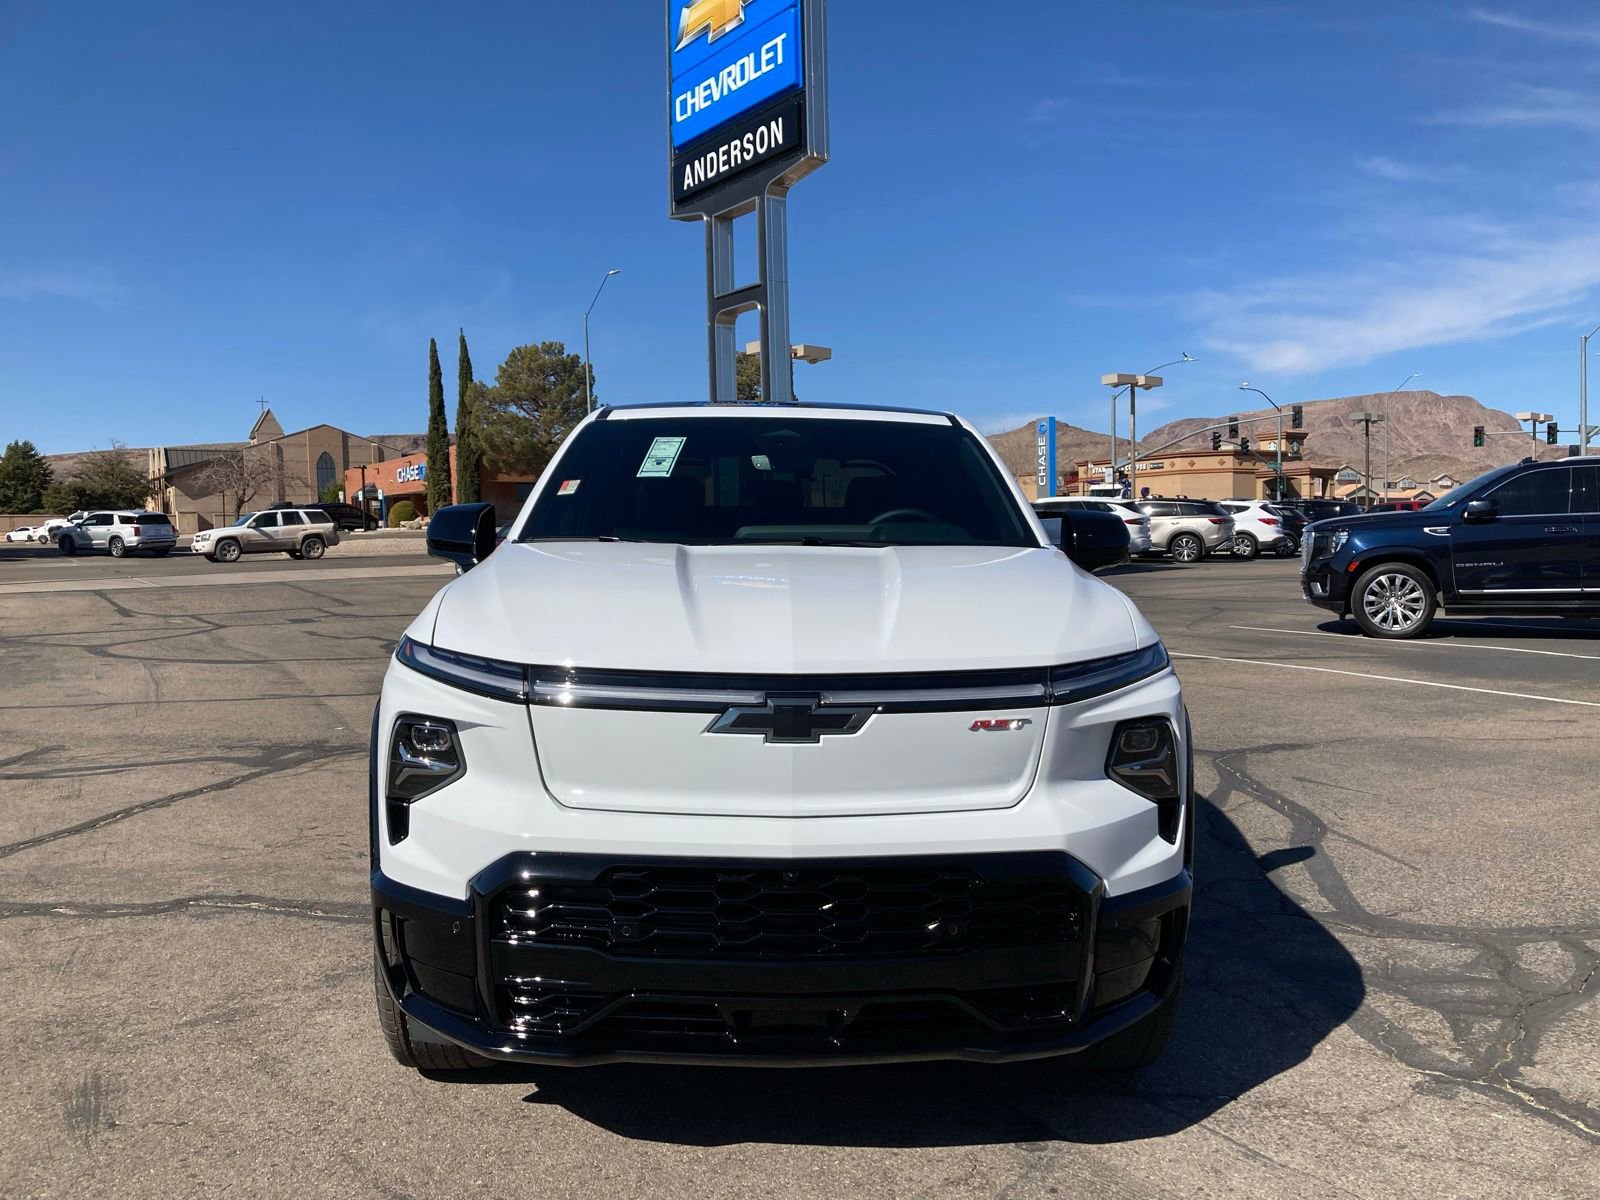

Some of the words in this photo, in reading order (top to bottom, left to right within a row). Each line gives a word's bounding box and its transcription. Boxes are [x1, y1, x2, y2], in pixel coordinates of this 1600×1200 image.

[675, 32, 787, 122] CHEVROLET
[683, 117, 783, 190] ANDERSON
[396, 464, 420, 483] CHASE
[1038, 436, 1046, 486] CHASE
